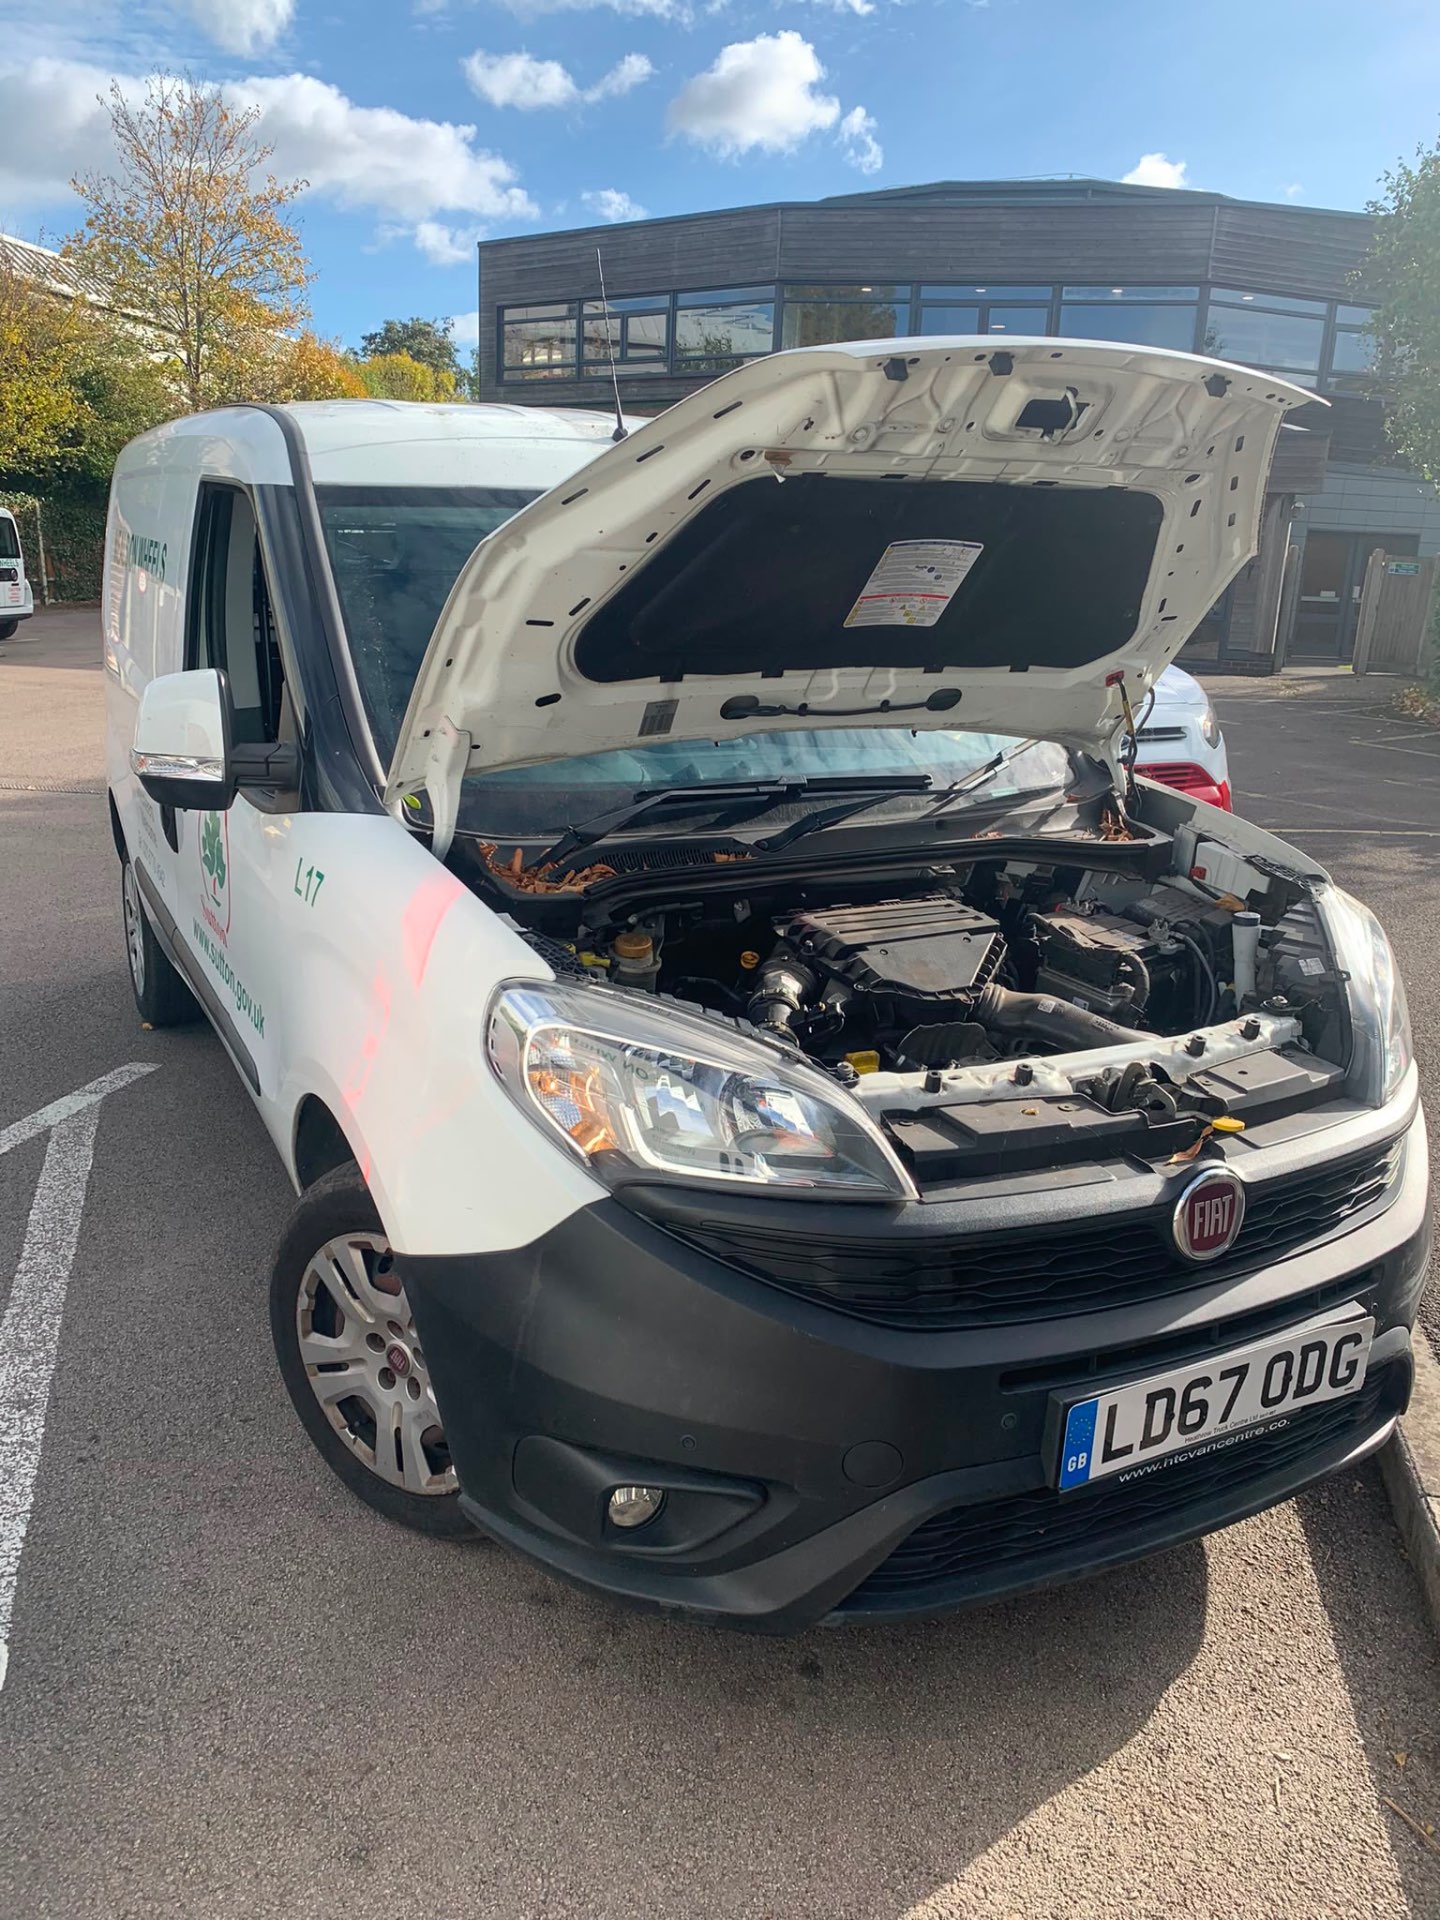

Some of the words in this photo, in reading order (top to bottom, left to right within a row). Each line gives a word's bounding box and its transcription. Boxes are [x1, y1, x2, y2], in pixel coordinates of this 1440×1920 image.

[294, 857, 325, 908] L17
[193, 917, 265, 1040] www.sutton.gov.uk
[1193, 1194, 1233, 1240] FIAT
[1101, 1363, 1250, 1464] LD67
[1260, 1332, 1363, 1409] ODG
[1213, 1424, 1229, 1436] Truck
[1229, 1417, 1248, 1429] Centre
[1067, 1452, 1087, 1473] GB
